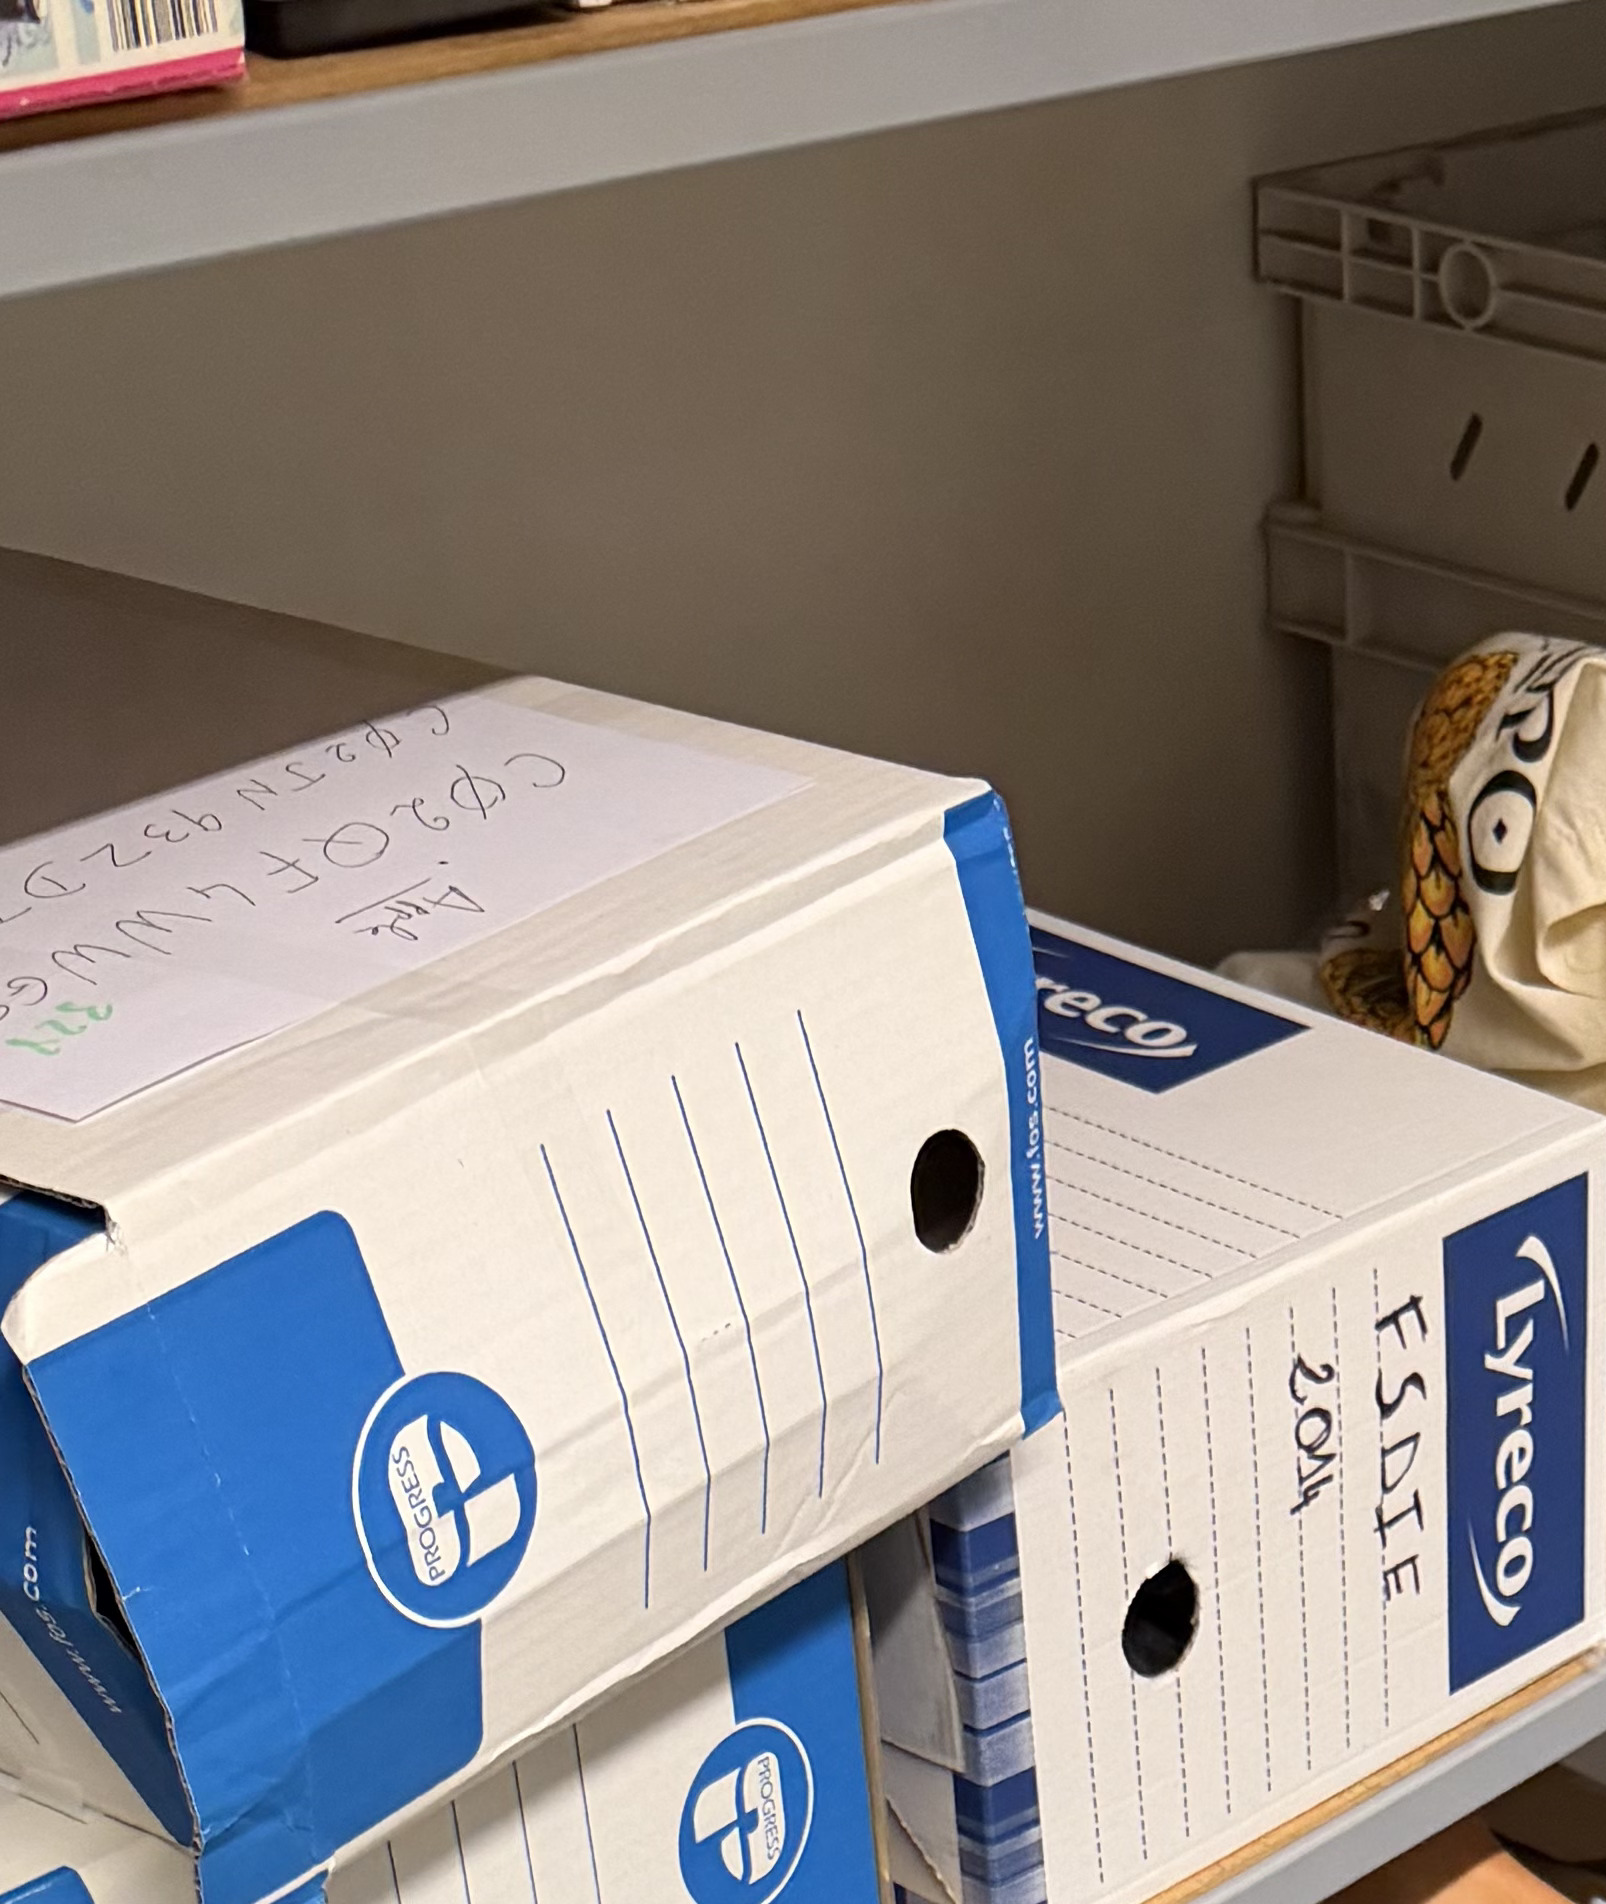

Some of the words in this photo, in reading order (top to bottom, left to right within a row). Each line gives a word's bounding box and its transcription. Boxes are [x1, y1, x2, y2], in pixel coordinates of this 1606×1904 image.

[1034, 976, 1189, 1048] reco
[391, 1445, 447, 1583] PROGRESS
[1288, 1352, 1339, 1517] 2014
[1374, 1293, 1430, 1603] FSDIE
[1482, 1277, 1547, 1600] Lyreco
[22, 1525, 122, 1714] www.fos.com
[757, 1756, 781, 1862] PROGRESS
